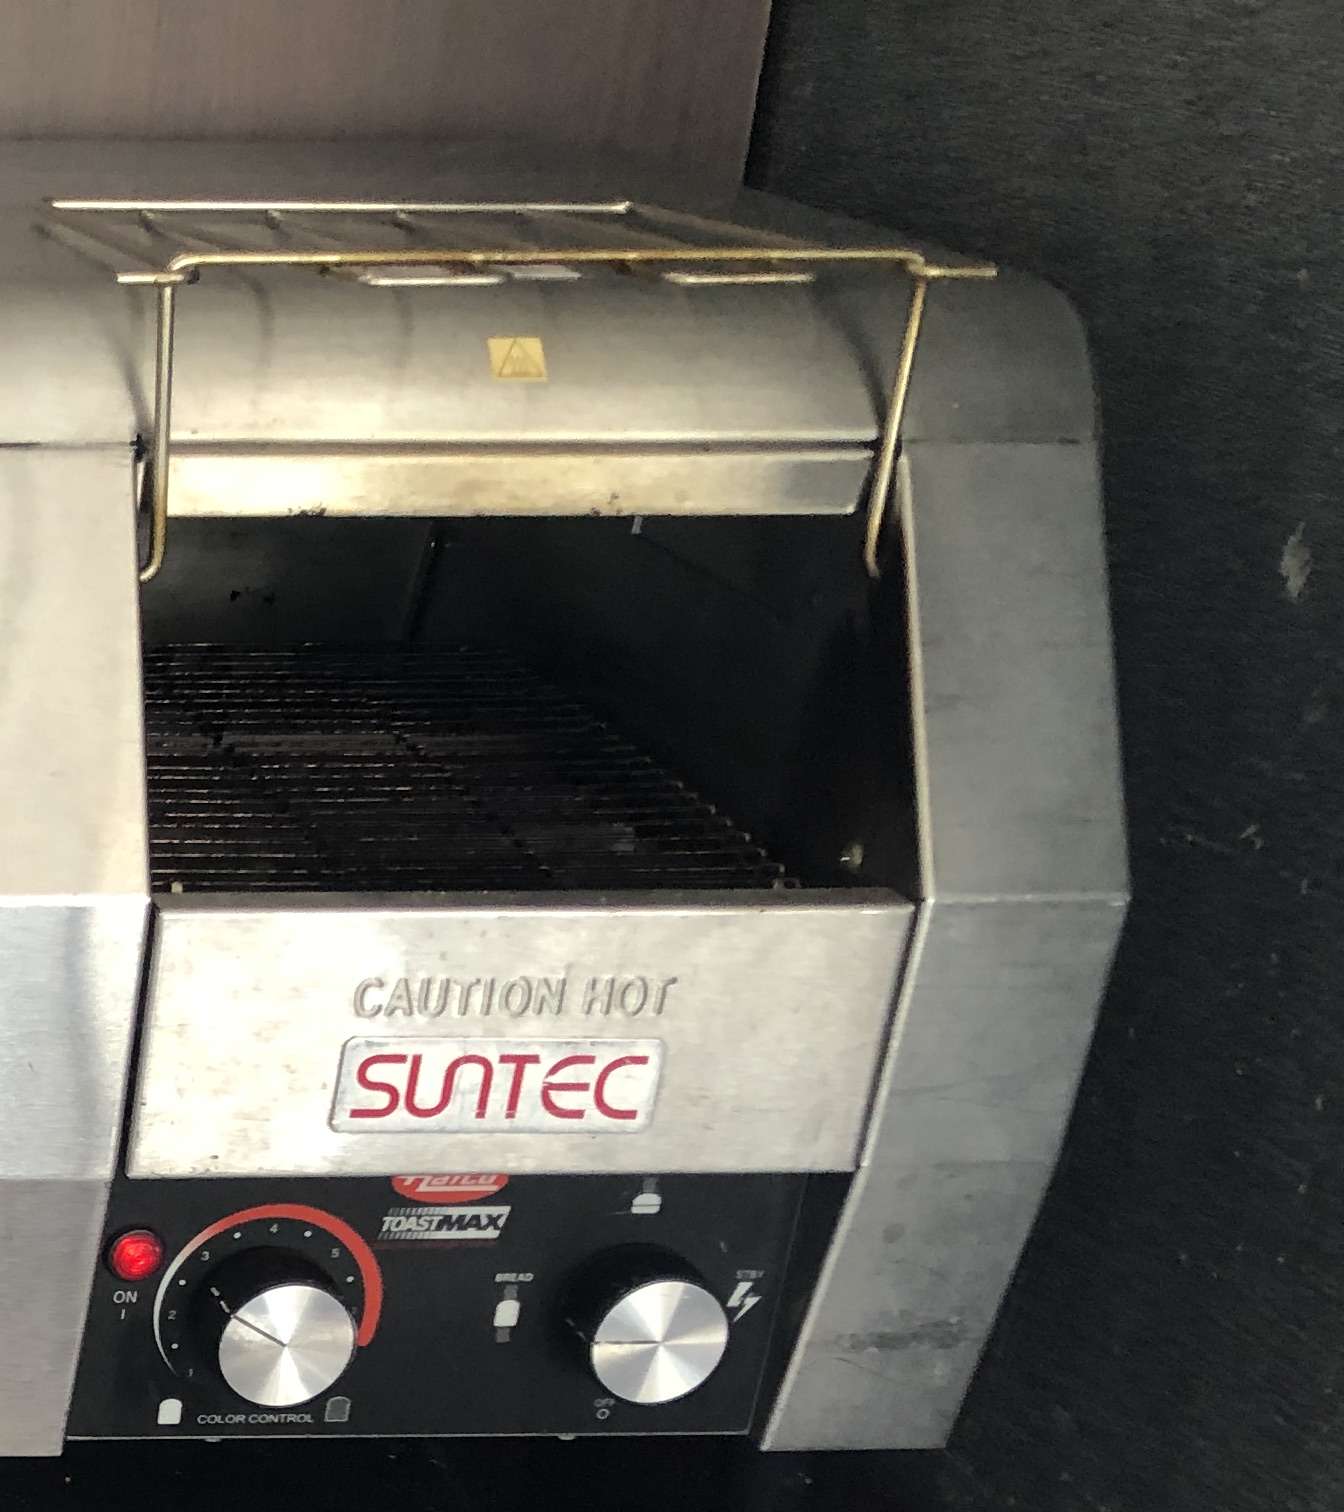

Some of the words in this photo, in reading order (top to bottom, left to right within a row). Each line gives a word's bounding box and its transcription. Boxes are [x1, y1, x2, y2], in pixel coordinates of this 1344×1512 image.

[353, 976, 567, 1019] CAUTION
[583, 975, 678, 1017] HOT
[349, 1053, 650, 1120] SUNTEC
[381, 1213, 505, 1232] TOASTMAX
[200, 1251, 210, 1261] 3
[112, 1290, 138, 1304] ON
[167, 1310, 177, 1320] 2
[197, 1413, 246, 1425] COLOR
[248, 1413, 313, 1424] CONTROL
